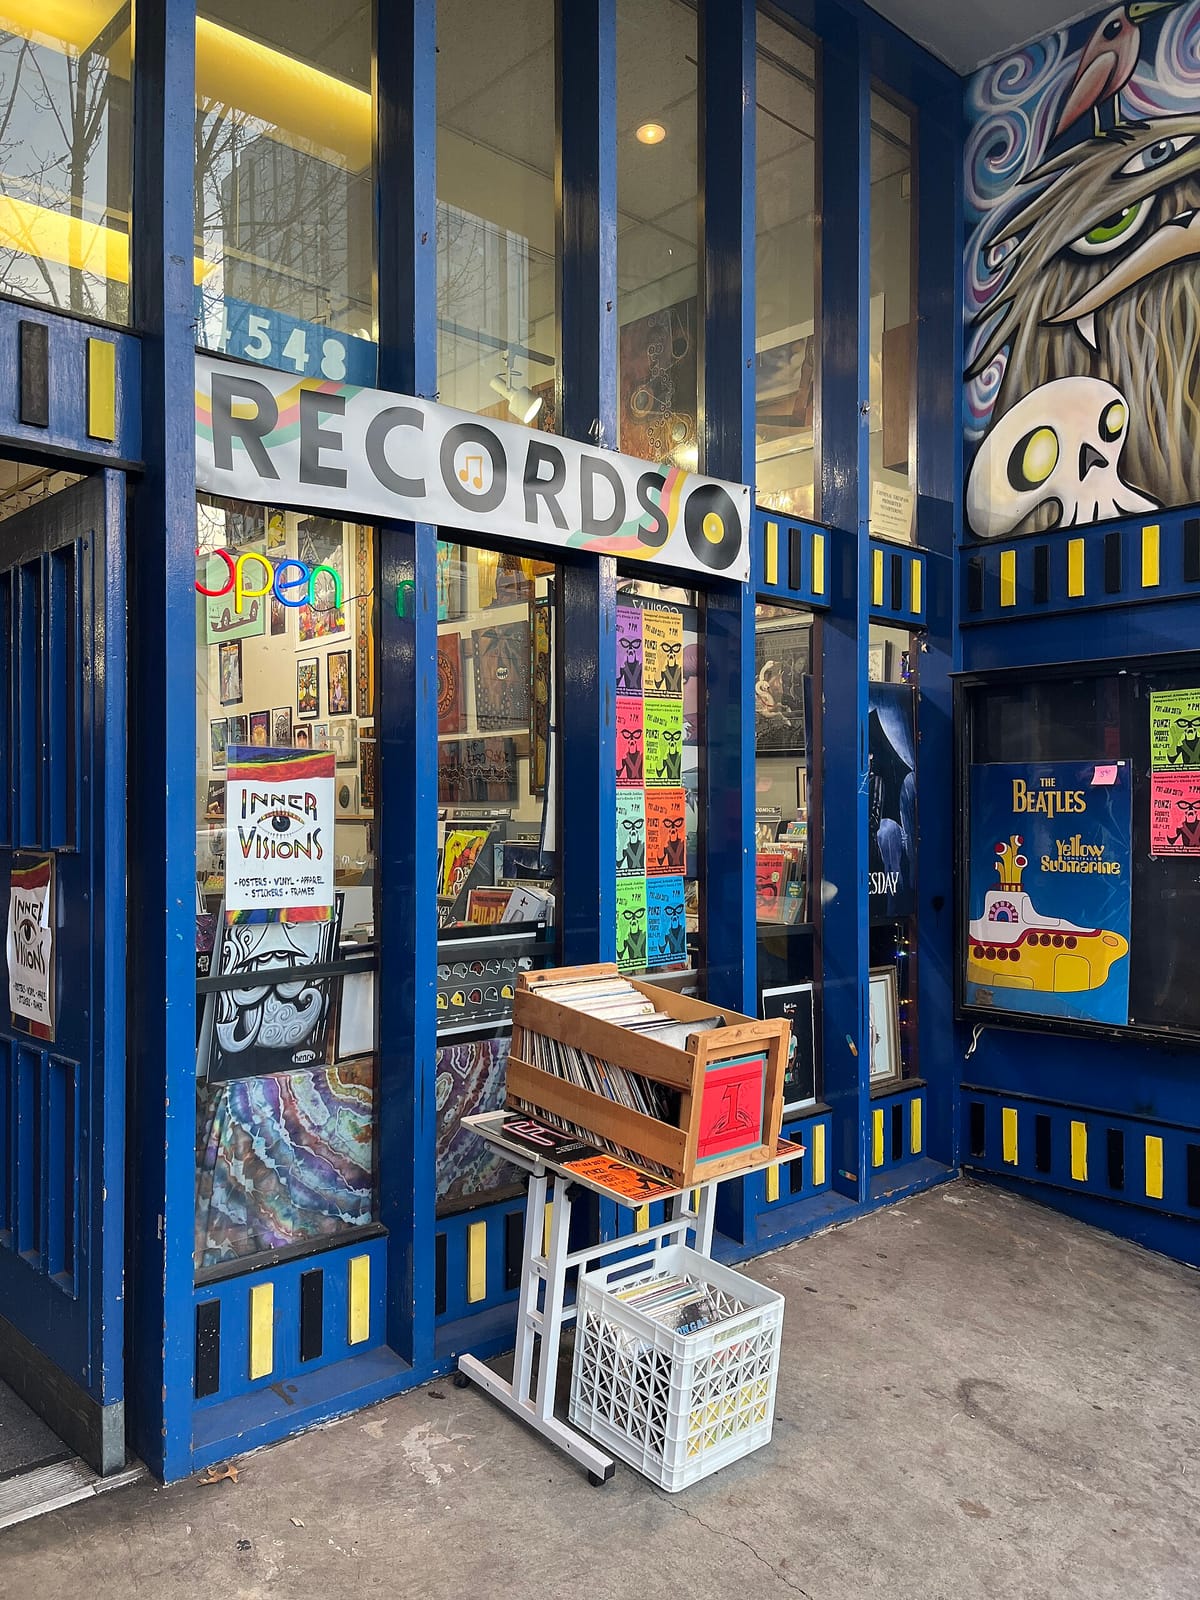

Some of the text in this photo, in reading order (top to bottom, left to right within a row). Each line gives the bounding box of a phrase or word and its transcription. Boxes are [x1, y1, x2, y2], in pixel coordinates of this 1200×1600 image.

[211, 372, 669, 547] RECORDS
[1040, 778, 1056, 787] THE
[242, 789, 317, 821] INNER
[1012, 779, 1086, 819] BEATLES
[238, 826, 323, 860] VISIONS
[1056, 834, 1105, 857] Yellow
[1041, 855, 1120, 874] Submarine
[238, 875, 324, 886] POSTERS VINYL APPAREL
[251, 887, 315, 898] STICKERS FRAMES
[14, 930, 45, 975] VISIONS
[294, 1050, 314, 1063] henry
